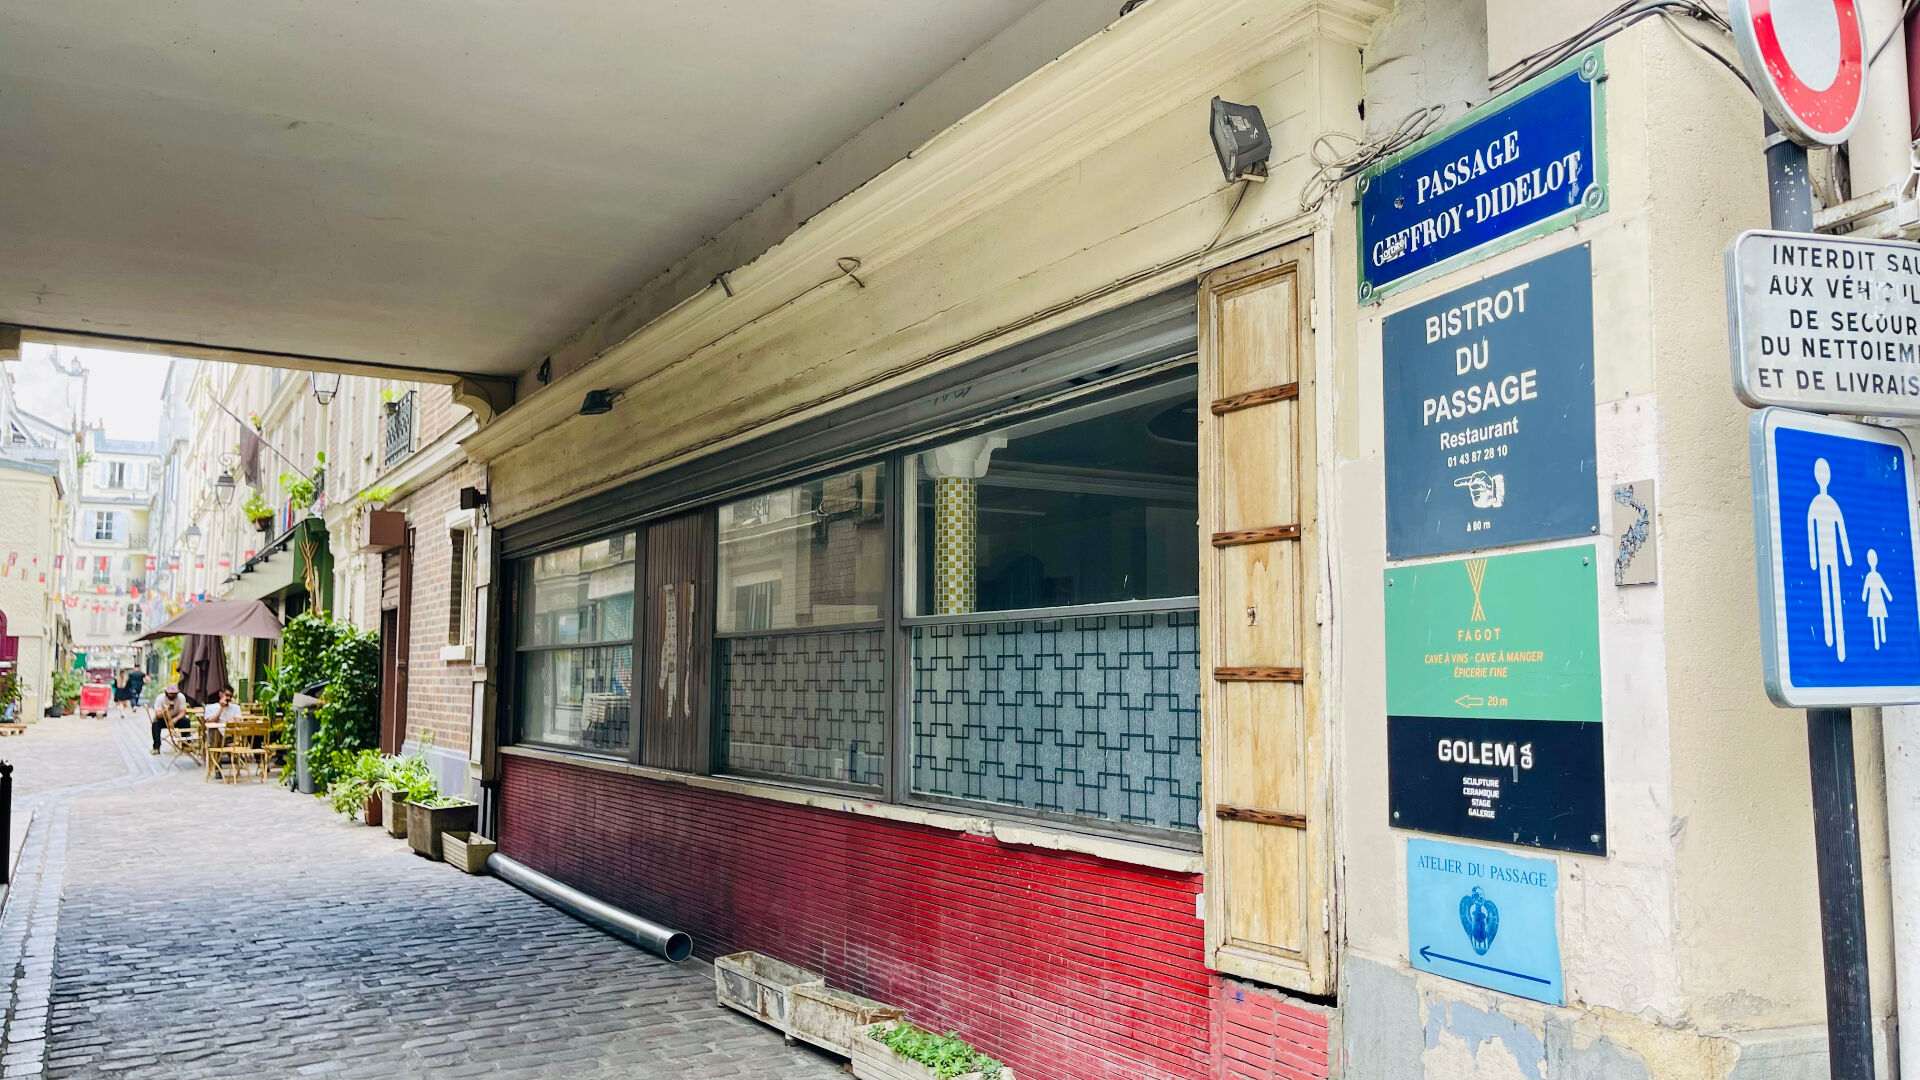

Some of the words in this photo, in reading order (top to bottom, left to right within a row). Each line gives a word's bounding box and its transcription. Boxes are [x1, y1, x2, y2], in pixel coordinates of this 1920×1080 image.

[1416, 130, 1520, 205] PASSAGE
[1773, 244, 1875, 271] INTERDIT
[1769, 274, 1814, 297] AUX
[1425, 282, 1530, 344] BISTROT
[1790, 309, 1819, 330] DE
[1831, 311, 1918, 336] SECOUR
[1456, 339, 1489, 376] DU
[1761, 335, 1791, 356] DU
[1802, 337, 1920, 364] NETTOIEM
[1758, 367, 1784, 389] ET
[1796, 370, 1825, 391] DE
[1836, 371, 1920, 396] LIVRAIS
[1423, 369, 1538, 426] PASSAGE
[1440, 415, 1519, 451] Restaurant
[1447, 456, 1457, 468] 01
[1459, 452, 1470, 465] 43
[1471, 450, 1482, 463] 87
[1484, 447, 1495, 460] 28
[1497, 444, 1508, 457] 10
[1483, 521, 1491, 529] m
[1457, 628, 1501, 641] FAGOT
[1424, 654, 1443, 664] CAVE
[1452, 652, 1469, 664] VINS
[1475, 652, 1497, 663] CAVE
[1506, 651, 1544, 663] MANGER
[1489, 667, 1509, 678] FINE
[1499, 697, 1508, 706] m
[1438, 739, 1515, 767] GOLEM
[1462, 777, 1500, 788] SCULPTURE
[1468, 807, 1496, 819] GALERIE
[1471, 798, 1492, 808] STAGE
[1417, 855, 1463, 874] ATELIER
[1468, 862, 1486, 878] DU
[1490, 865, 1549, 888] PASSAGE
